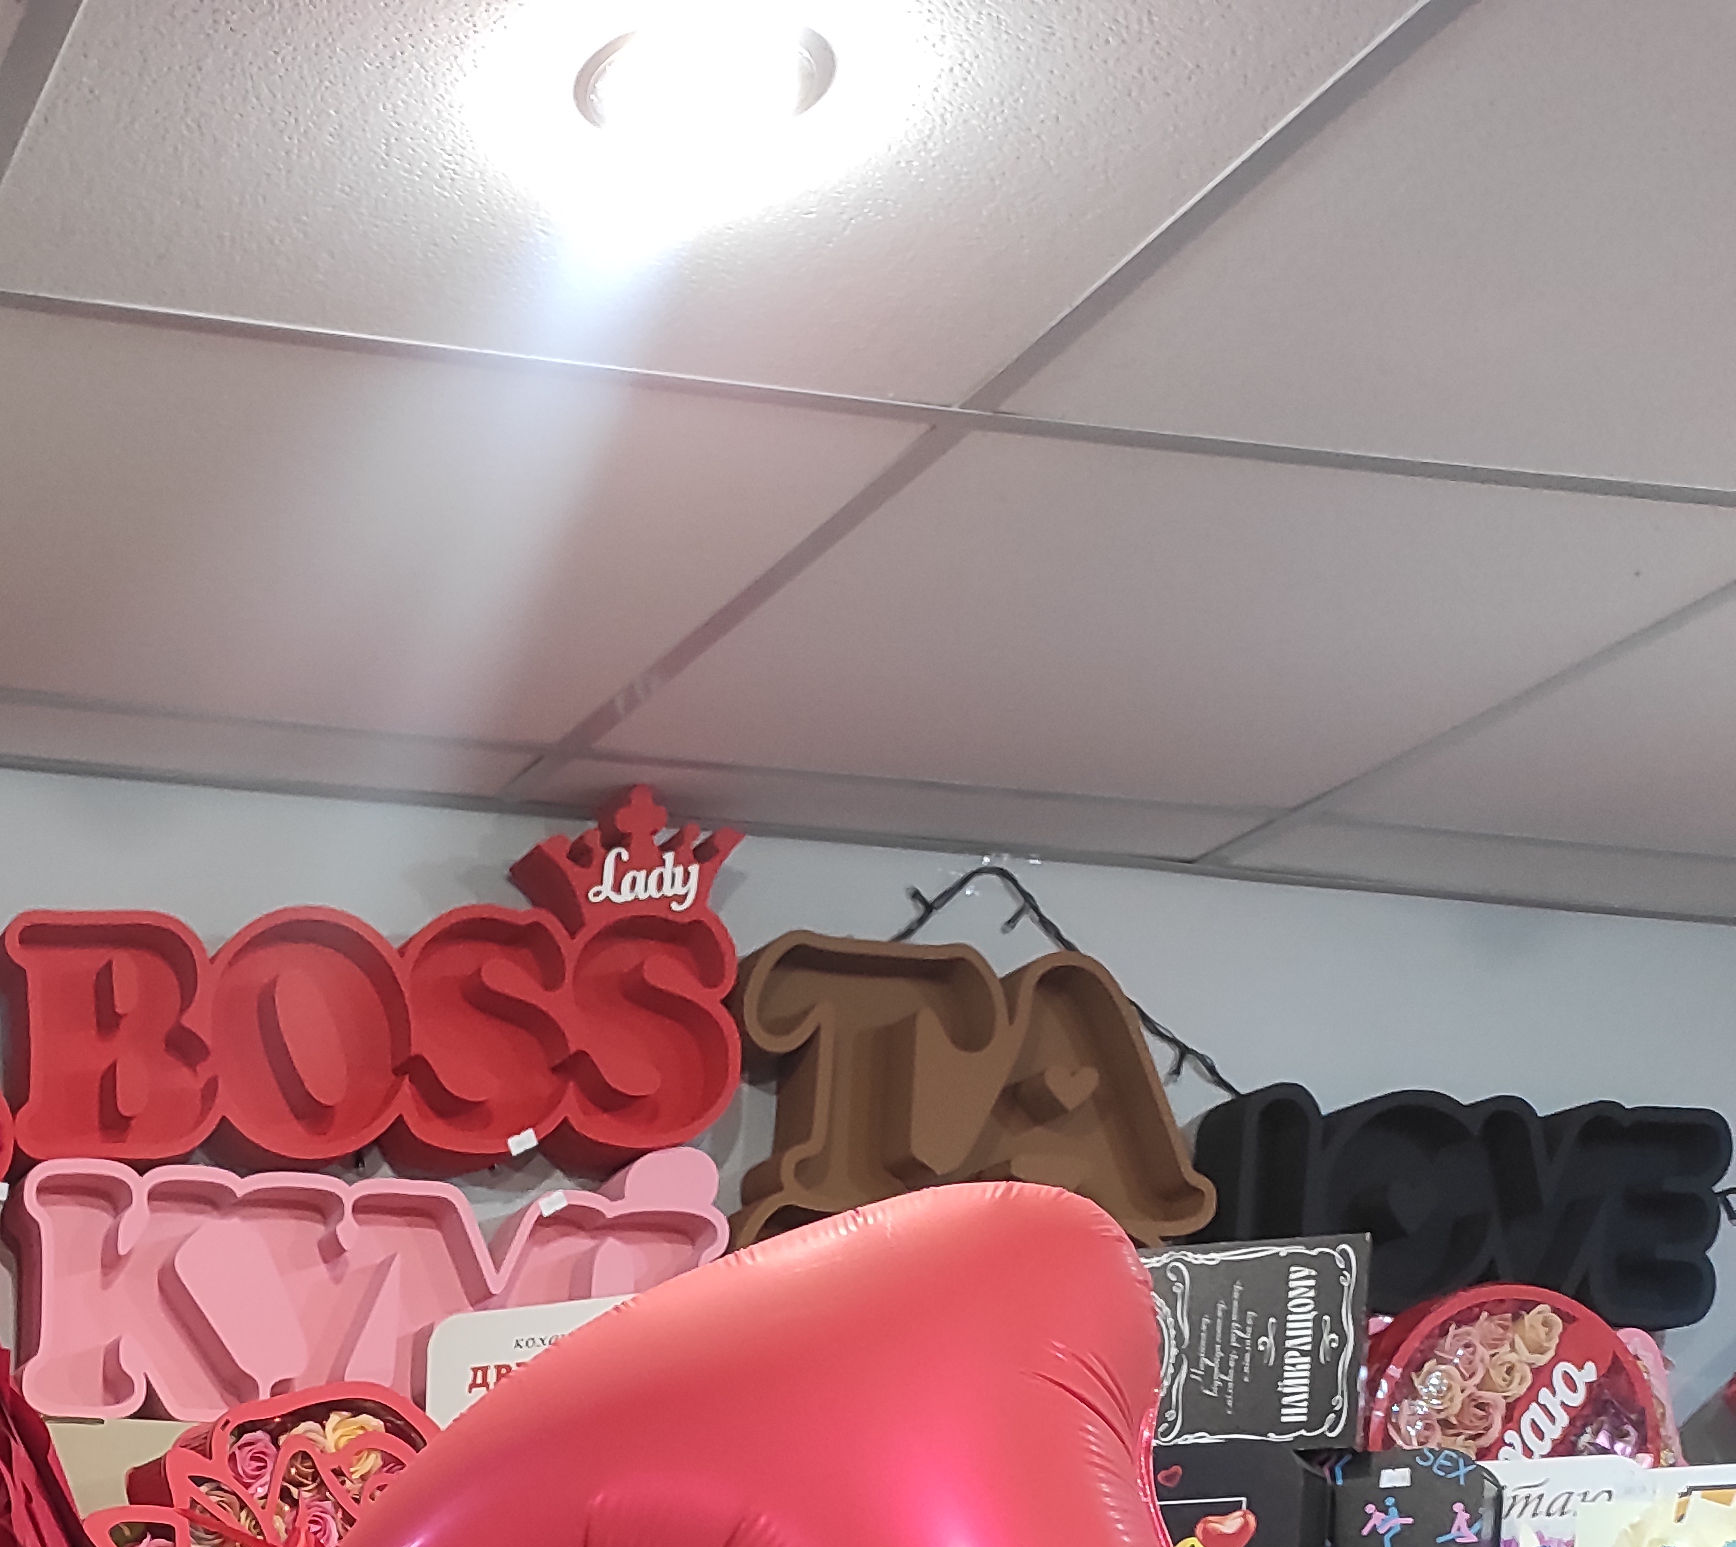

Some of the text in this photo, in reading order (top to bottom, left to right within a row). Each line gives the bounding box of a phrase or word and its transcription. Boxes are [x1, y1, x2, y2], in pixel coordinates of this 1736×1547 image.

[587, 846, 700, 912] Lady
[4, 904, 743, 1160] BOSS
[1276, 1264, 1319, 1424] НАЙКРАЩОМУ
[1415, 1446, 1477, 1486] SEX
